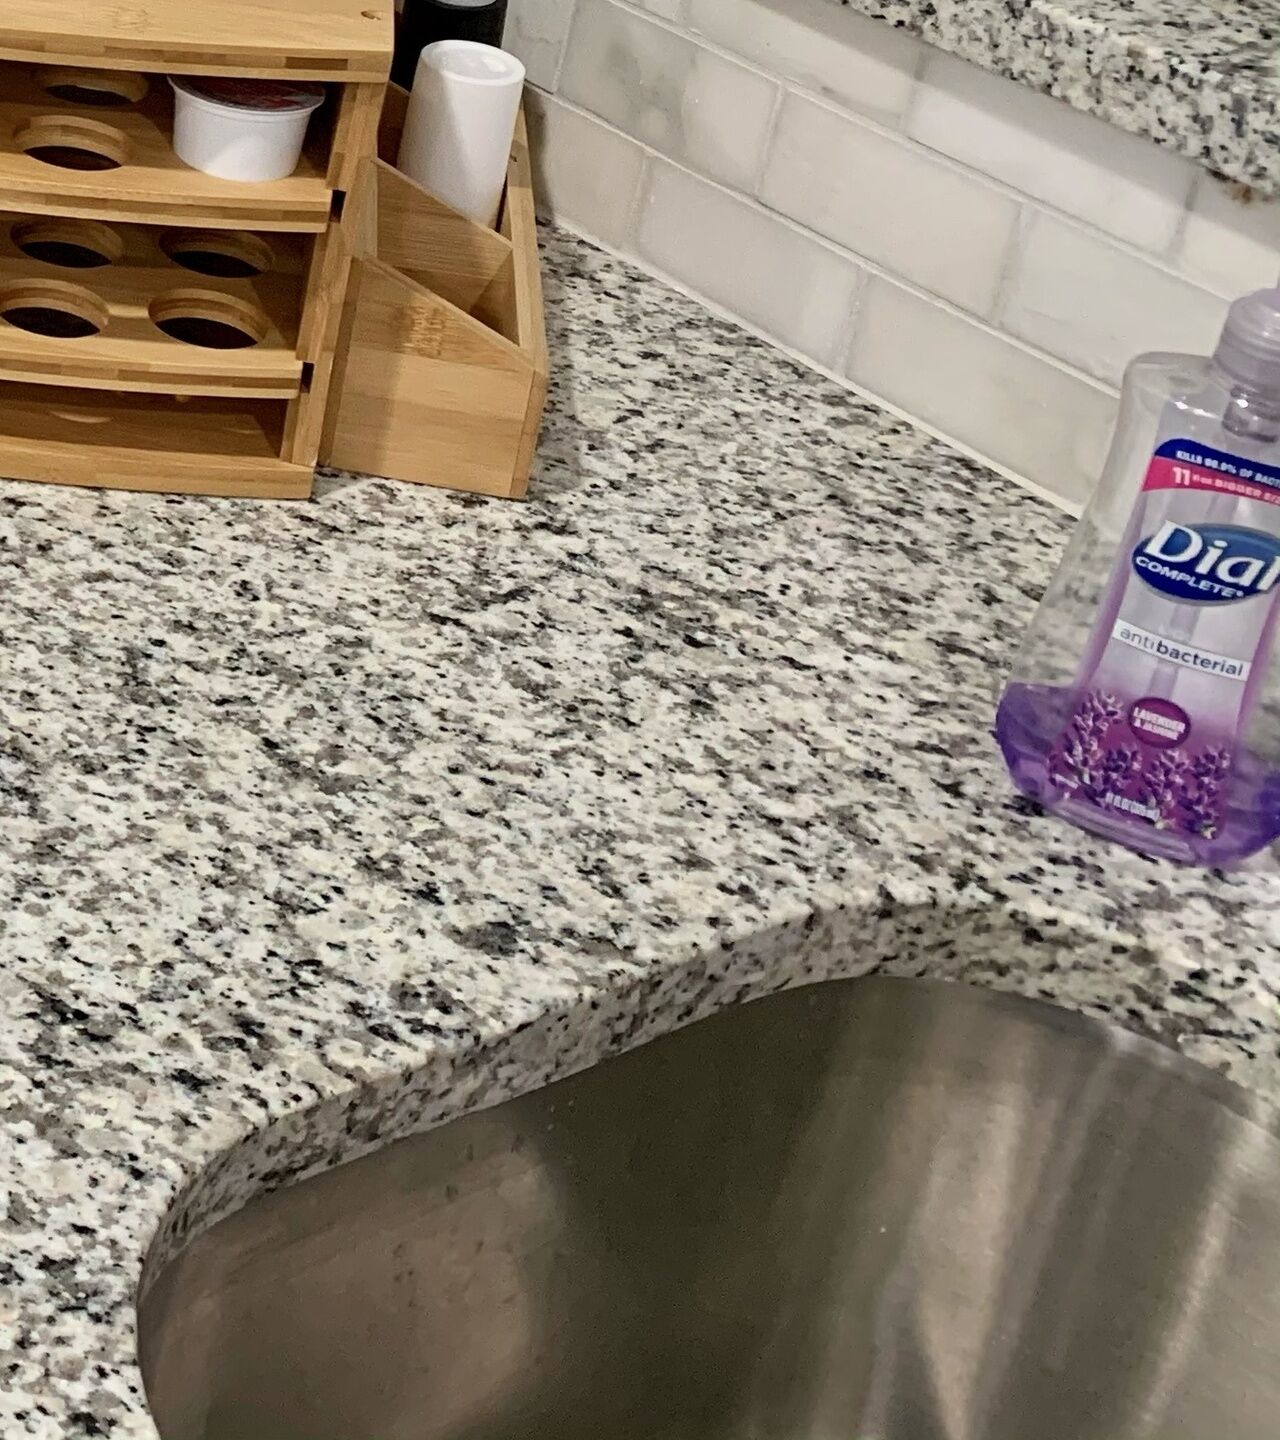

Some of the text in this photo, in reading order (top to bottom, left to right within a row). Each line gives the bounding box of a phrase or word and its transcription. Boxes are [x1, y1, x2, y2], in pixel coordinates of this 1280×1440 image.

[1173, 467, 1190, 486] 11
[1143, 520, 1280, 591] Dial
[1120, 627, 1243, 677] antibacterial
